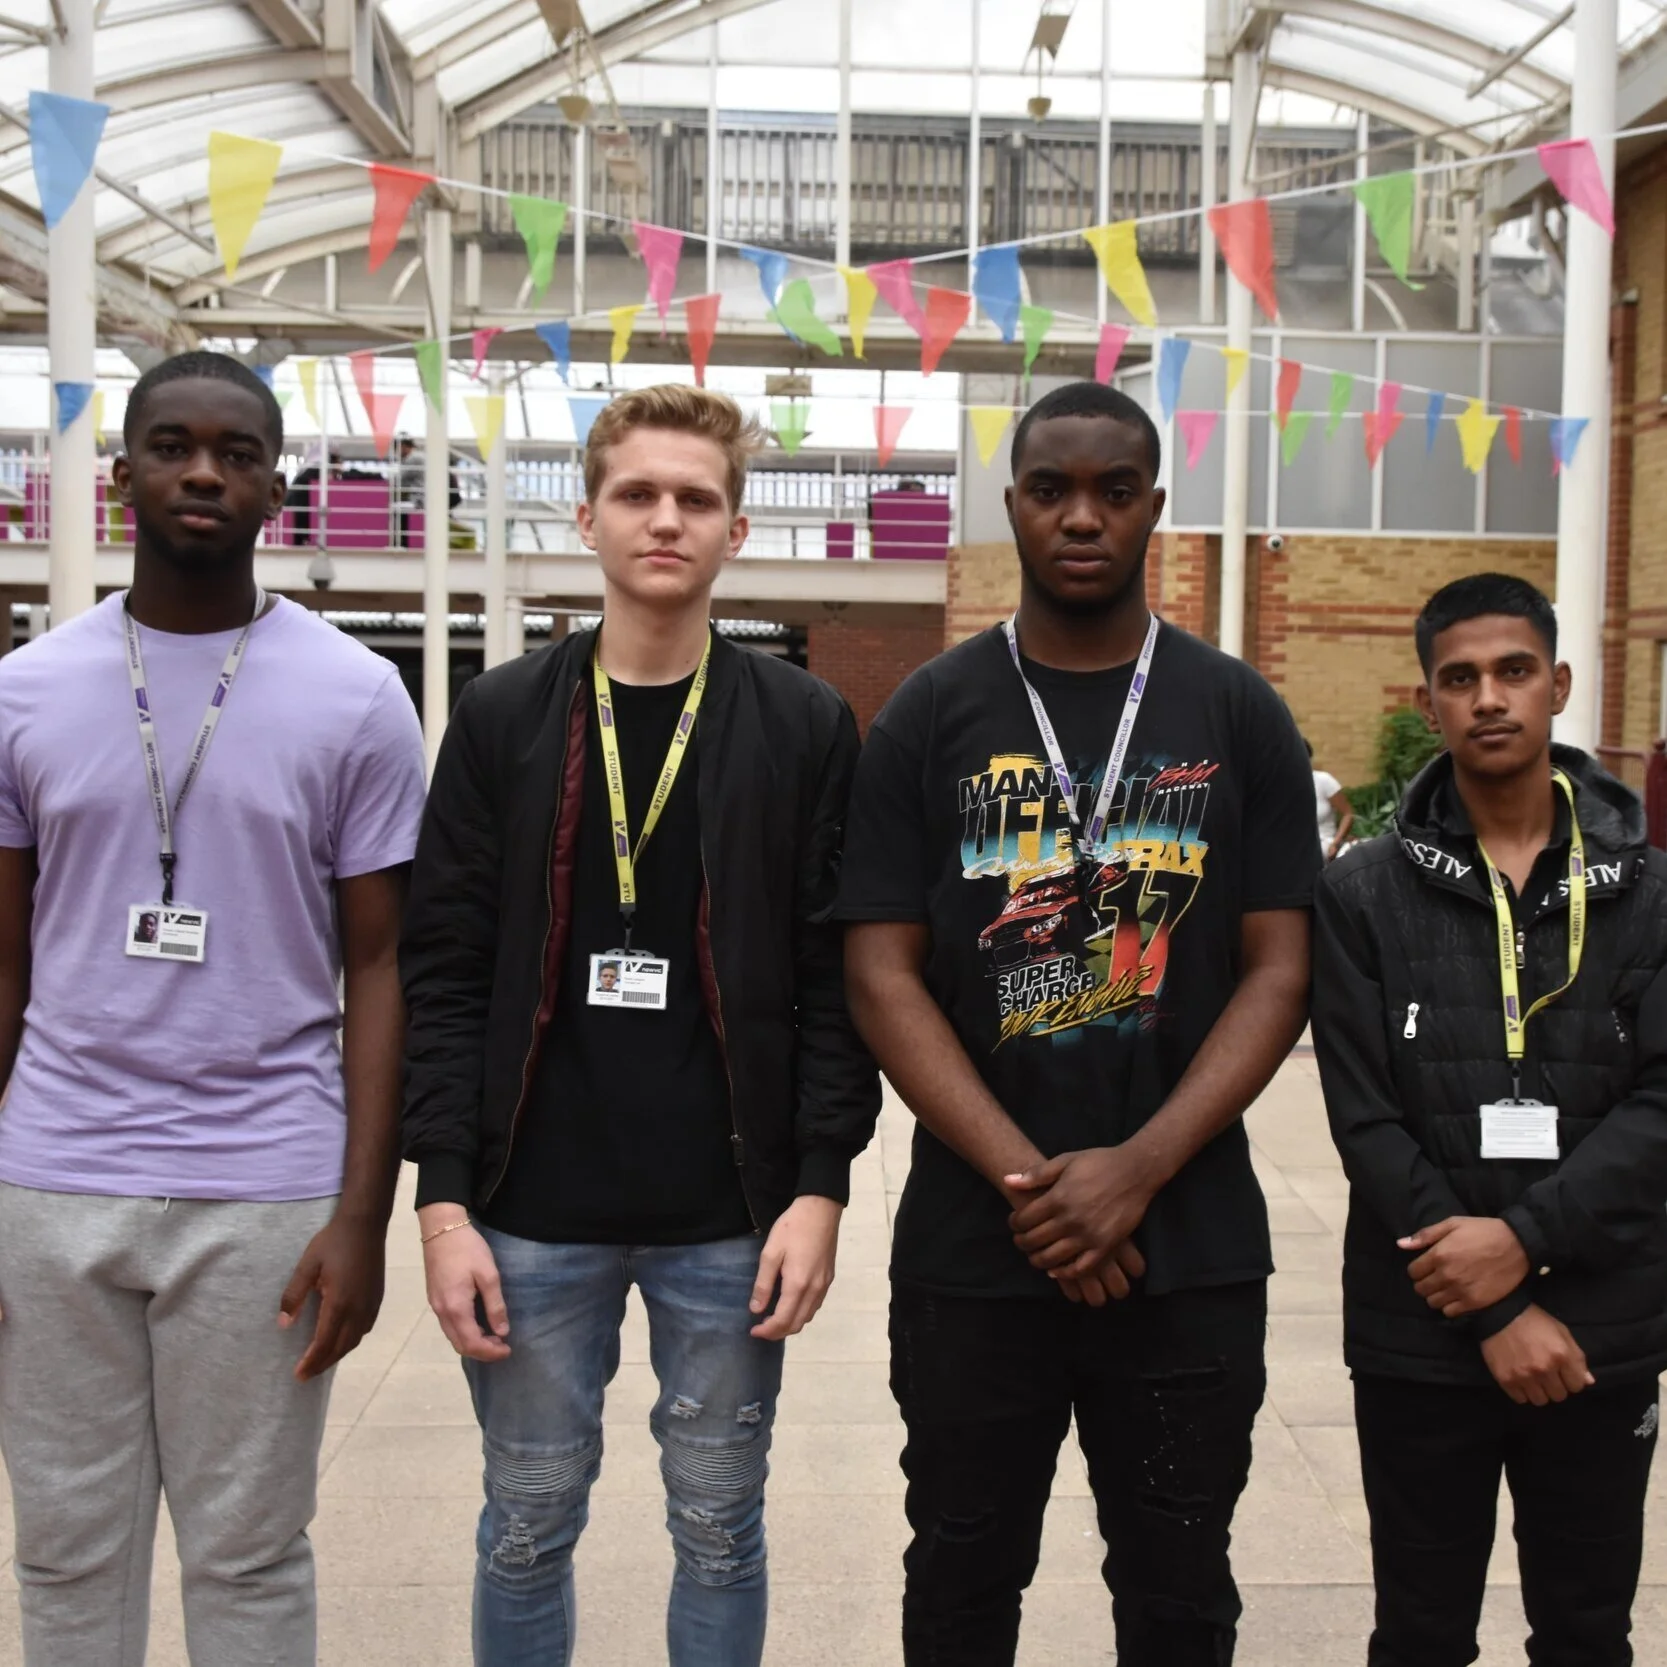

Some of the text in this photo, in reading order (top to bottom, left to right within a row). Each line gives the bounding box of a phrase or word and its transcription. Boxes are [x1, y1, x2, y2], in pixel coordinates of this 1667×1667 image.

[1035, 701, 1054, 746] COUNCILLOR
[608, 750, 621, 796] STUDENT
[1104, 718, 1131, 799] STUDENT COUNCILLOR
[653, 765, 674, 810] STUDENT
[959, 765, 1053, 813] MAN
[1157, 782, 1209, 795] RACEWAY
[1099, 868, 1202, 996] 17
[1504, 923, 1512, 970] STUDENT
[1571, 900, 1582, 947] STUDENT
[998, 955, 1076, 998] SUPER
